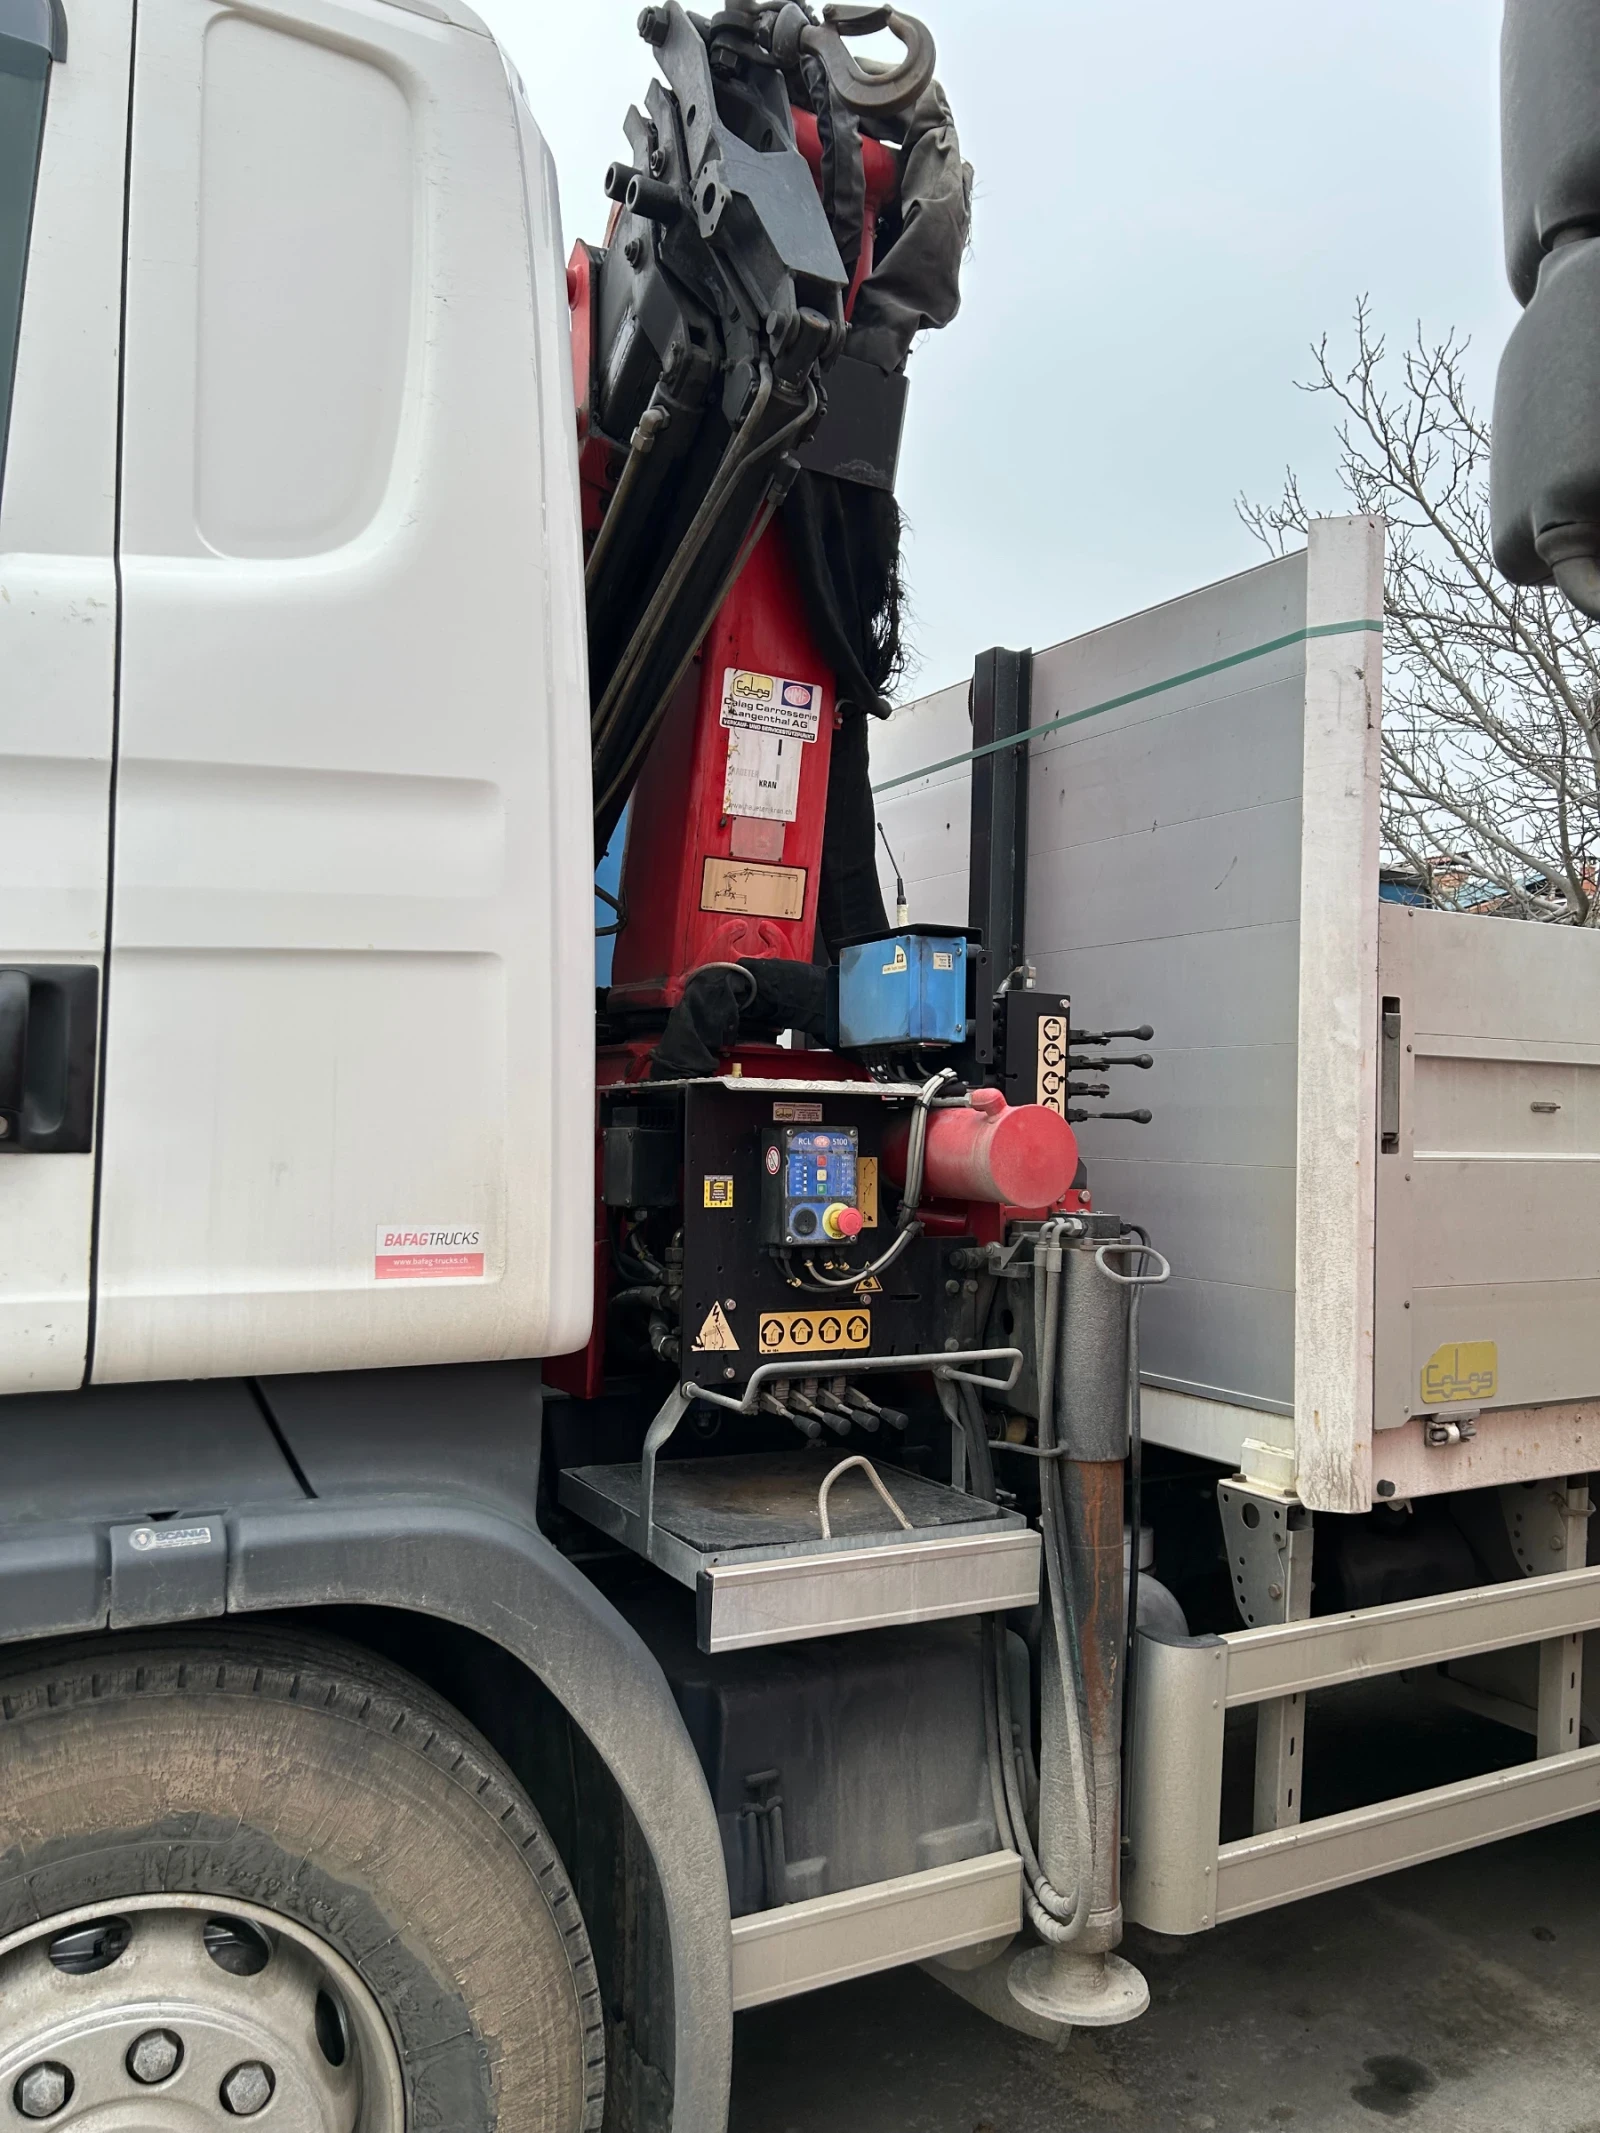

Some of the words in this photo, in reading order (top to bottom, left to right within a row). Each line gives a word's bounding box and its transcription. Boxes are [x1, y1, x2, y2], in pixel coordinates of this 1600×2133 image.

[724, 697, 754, 711] Calag
[755, 703, 818, 722] Carrosserie
[748, 722, 762, 731] UND
[791, 719, 808, 729] AG
[758, 779, 778, 790] KRAN
[798, 1137, 811, 1145] RCL
[832, 1138, 848, 1146] 5100
[393, 1257, 469, 1266] www.bafag-trucks.ch
[155, 1528, 208, 1541] SCANIA
